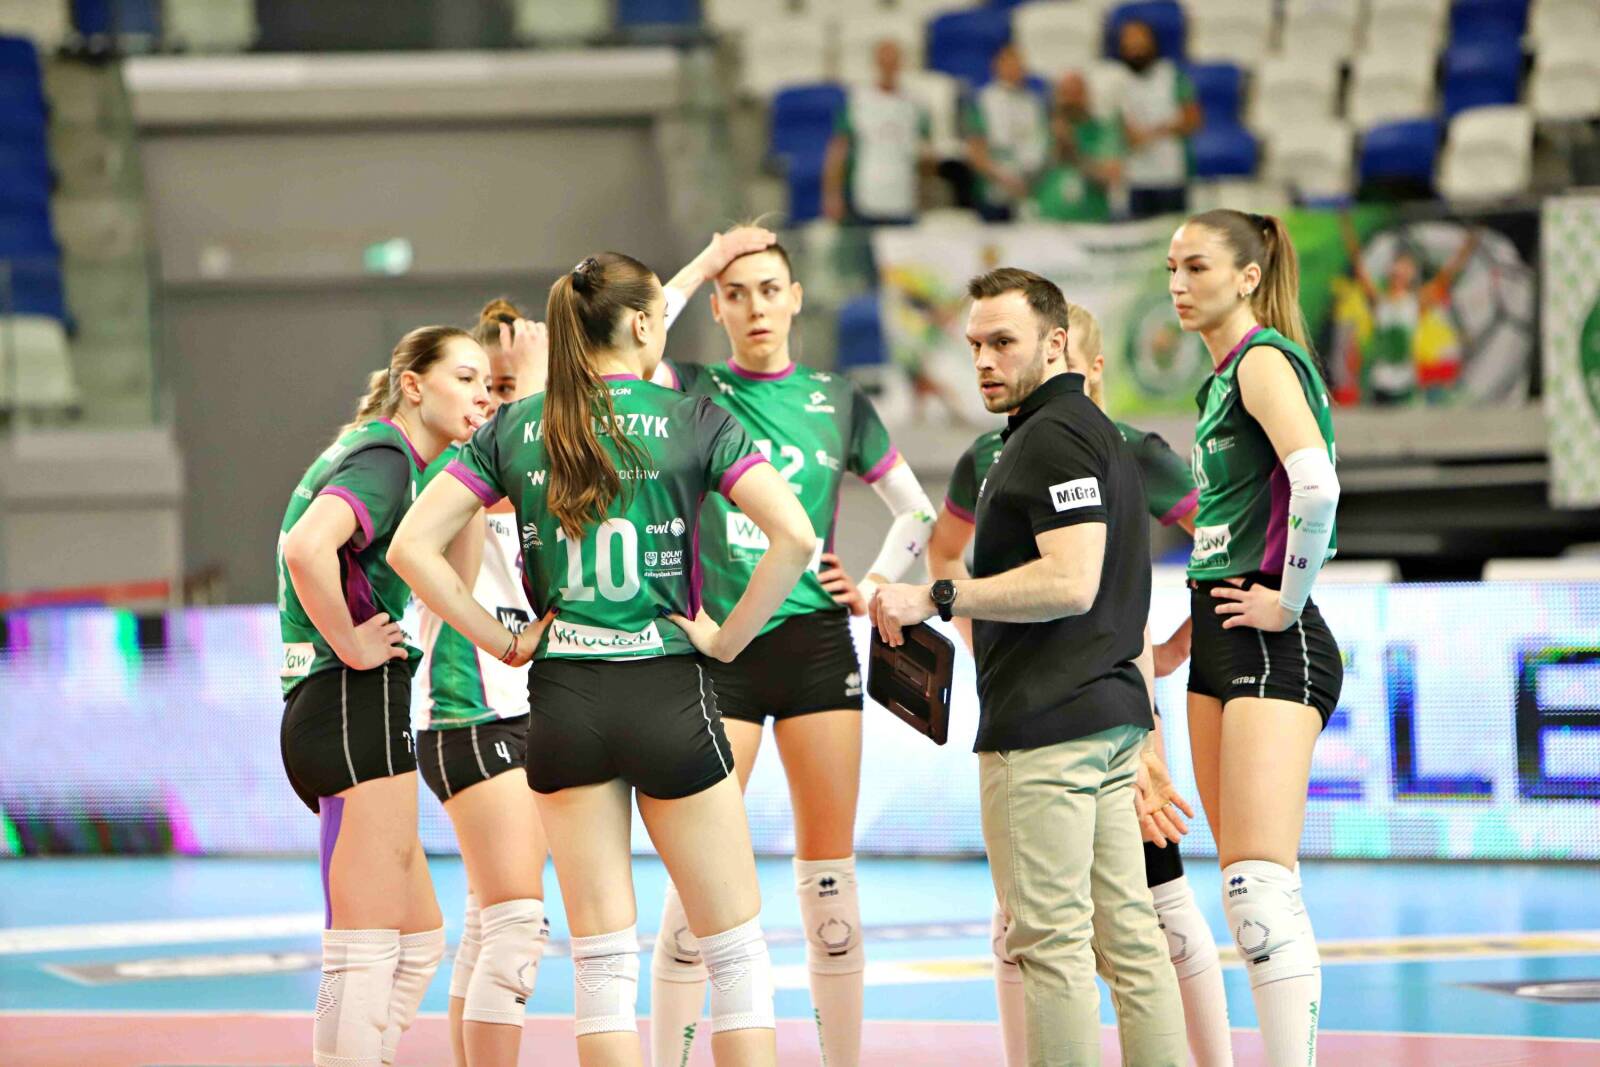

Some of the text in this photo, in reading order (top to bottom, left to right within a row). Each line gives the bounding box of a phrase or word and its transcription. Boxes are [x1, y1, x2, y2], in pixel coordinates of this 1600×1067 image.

[1056, 486, 1097, 504] MiGra
[646, 520, 670, 534] ewl
[556, 517, 641, 602] 10
[1288, 554, 1308, 569] 18
[494, 740, 512, 764] 4
[1229, 887, 1248, 898] errea
